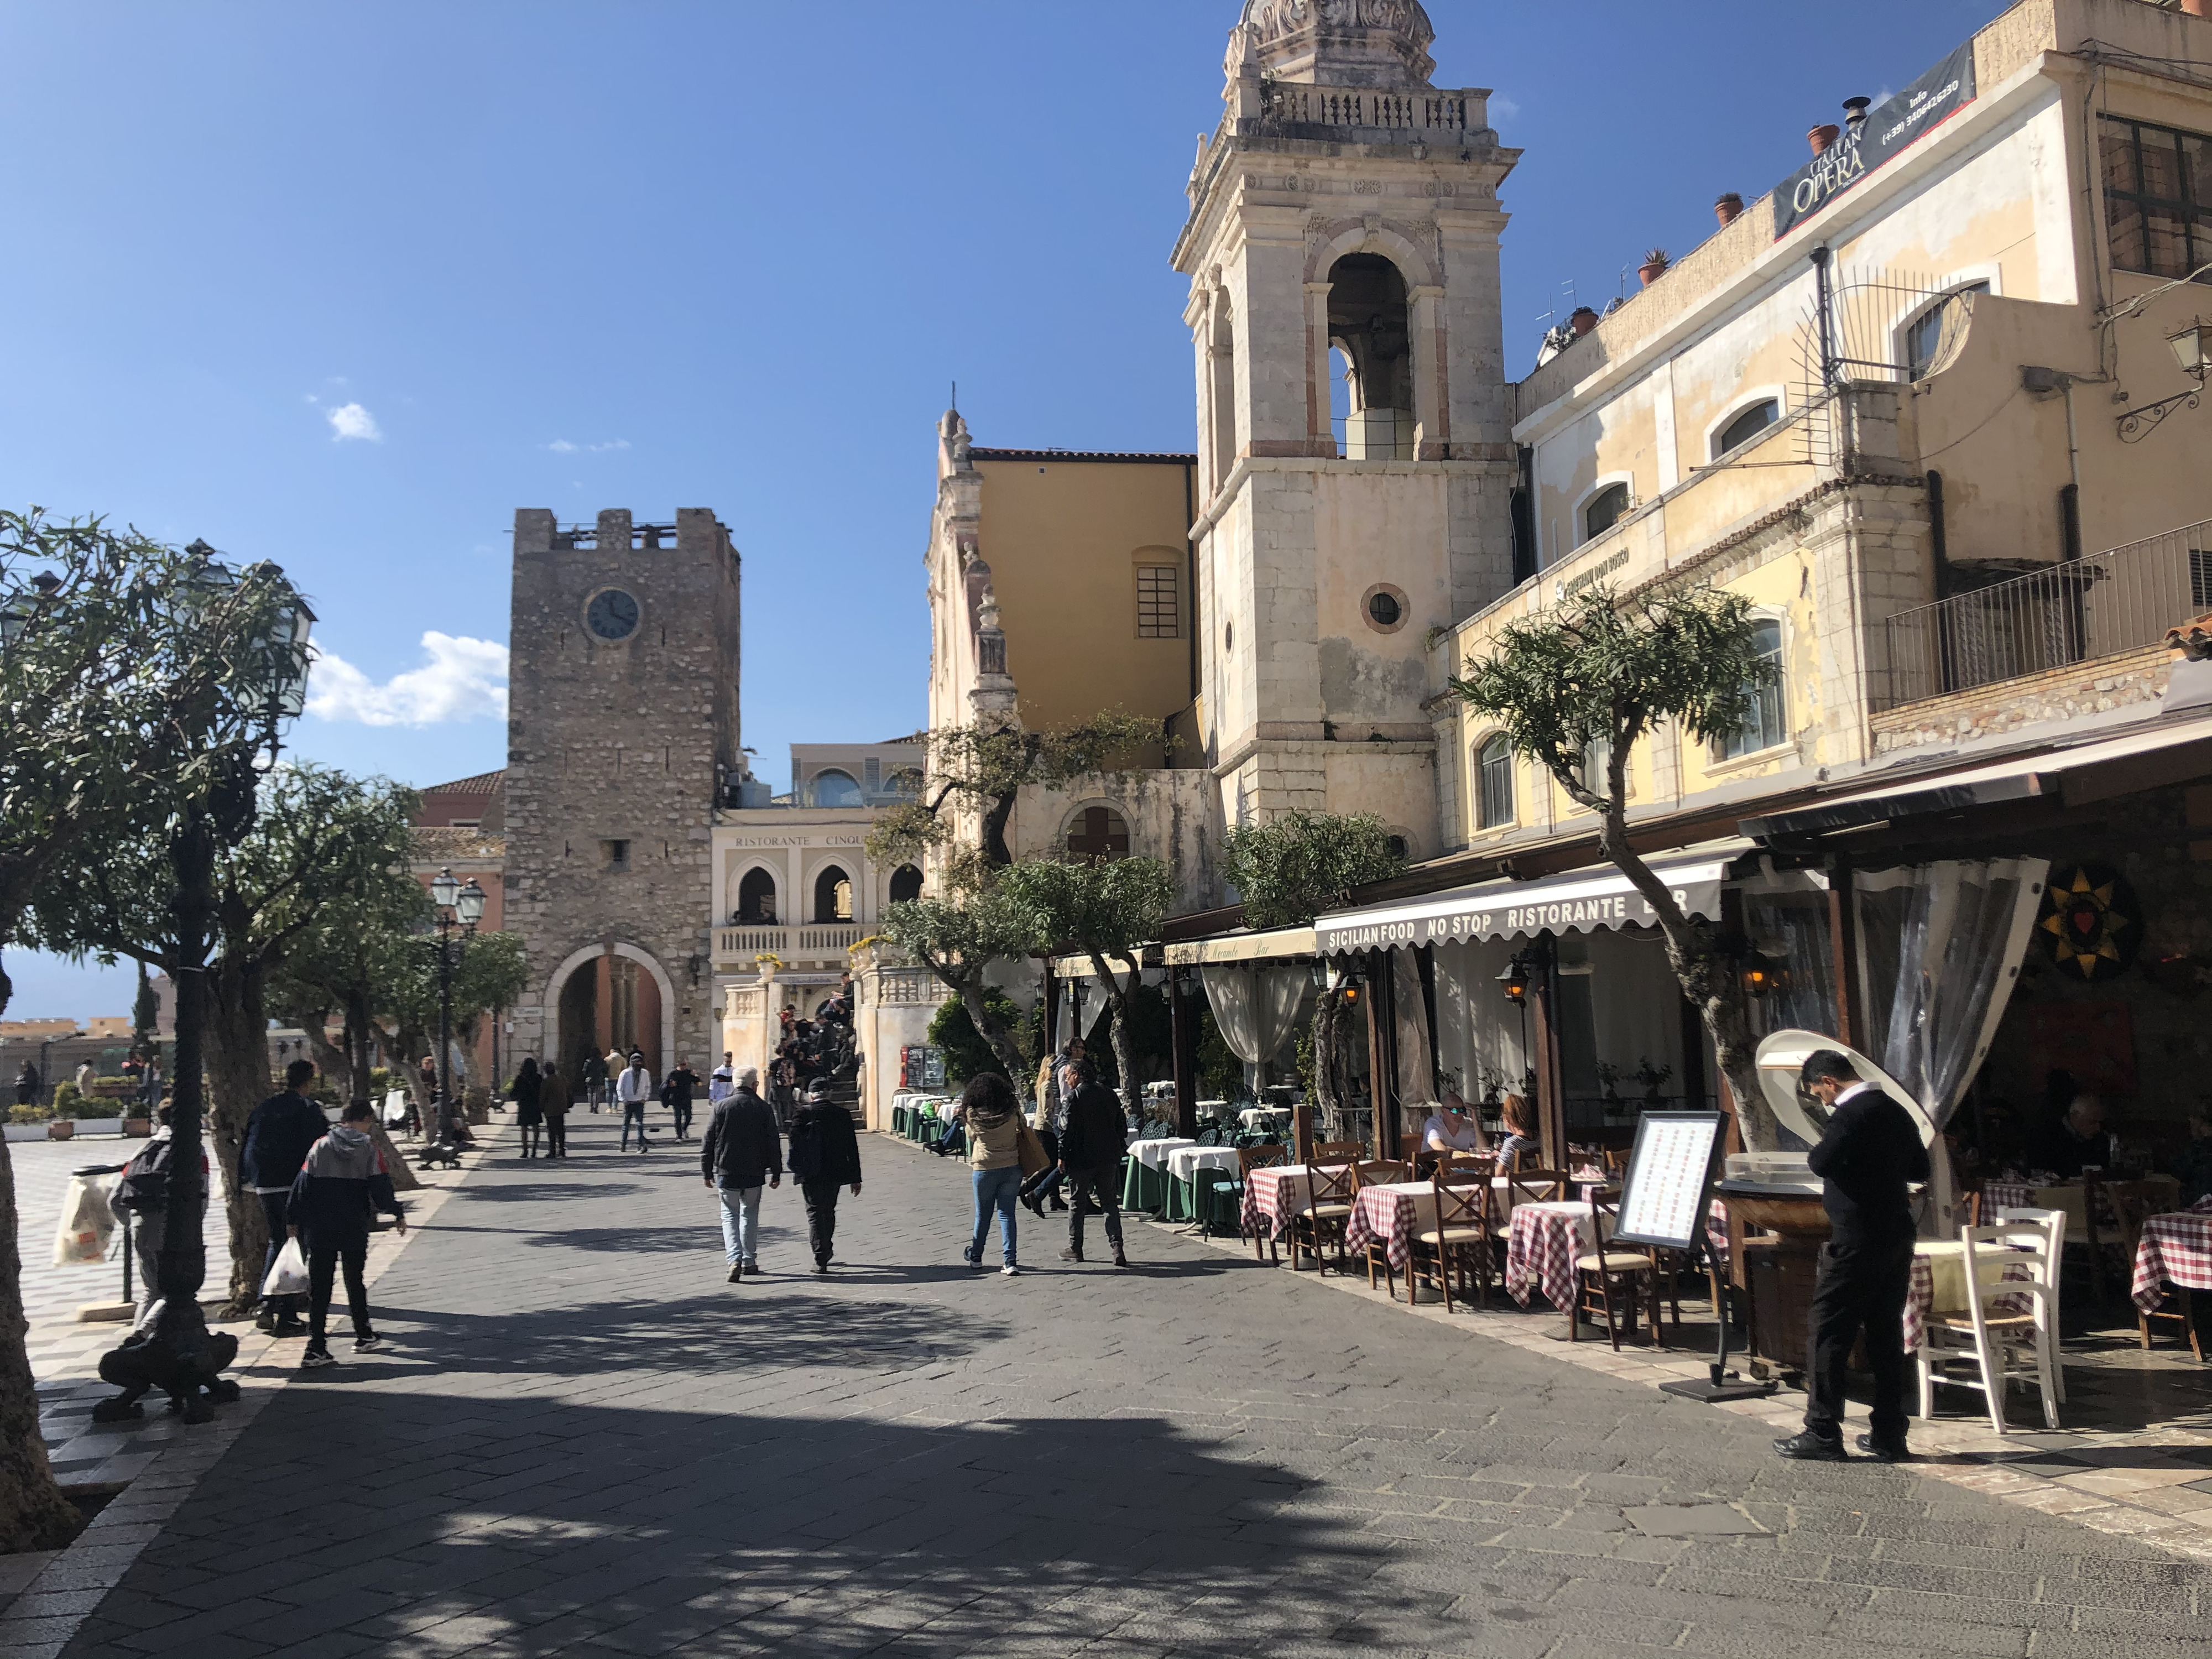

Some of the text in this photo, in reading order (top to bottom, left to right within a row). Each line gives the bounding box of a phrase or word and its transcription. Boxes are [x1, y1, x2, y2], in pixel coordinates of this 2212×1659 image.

[1910, 91, 1928, 109] Info
[1882, 121, 1905, 145] (+39)
[1810, 127, 1861, 178] ITALIAN
[1793, 147, 1866, 213] OPERA
[736, 836, 810, 847] RISTORANTE
[1329, 926, 1379, 948] SICILIAN
[1381, 921, 1415, 941] FOOD
[1427, 917, 1447, 936] NO
[1452, 914, 1491, 934] STOP
[1507, 896, 1626, 928] RISTORANTE
[1253, 938, 1270, 957] Bar
